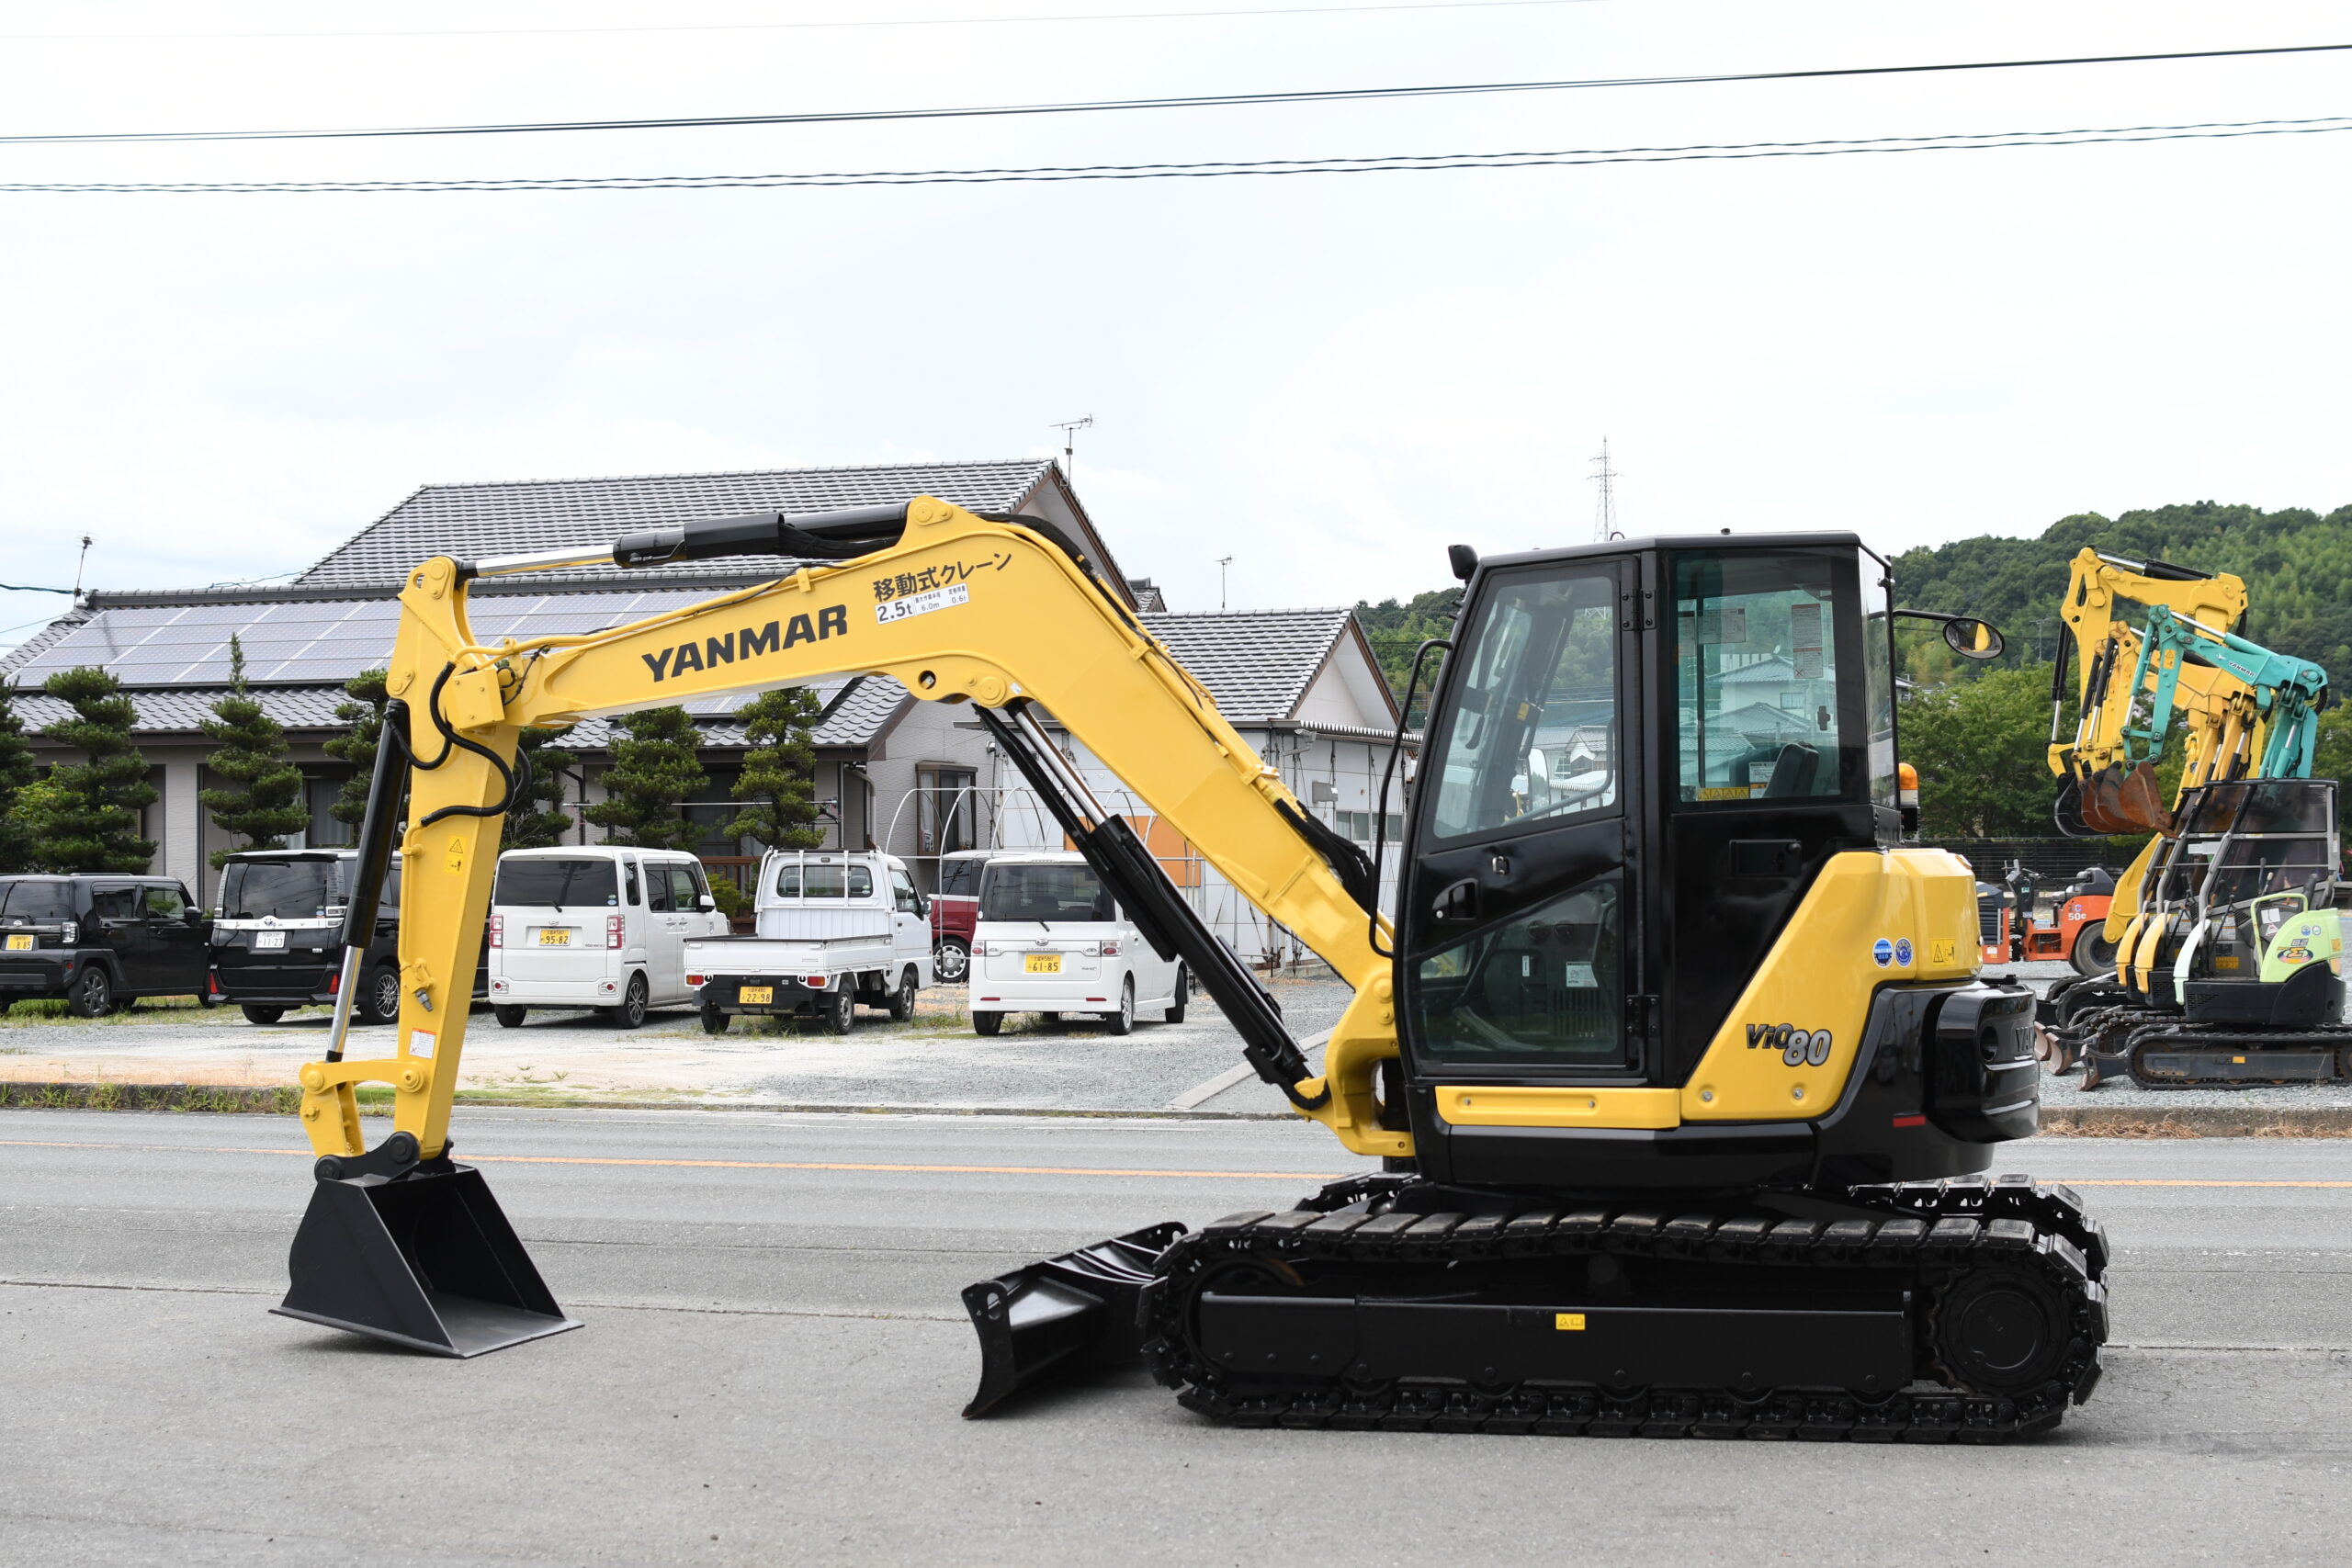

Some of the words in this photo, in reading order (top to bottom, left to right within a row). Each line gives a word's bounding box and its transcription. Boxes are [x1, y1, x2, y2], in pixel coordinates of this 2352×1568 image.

[873, 554, 1012, 603] 移動式クレーン
[876, 601, 913, 622] 2.5t
[921, 602, 940, 612] 6.0m
[641, 604, 847, 682] YANMAR
[2228, 660, 2256, 677] YANMAR
[1033, 962, 1058, 972] 61-85
